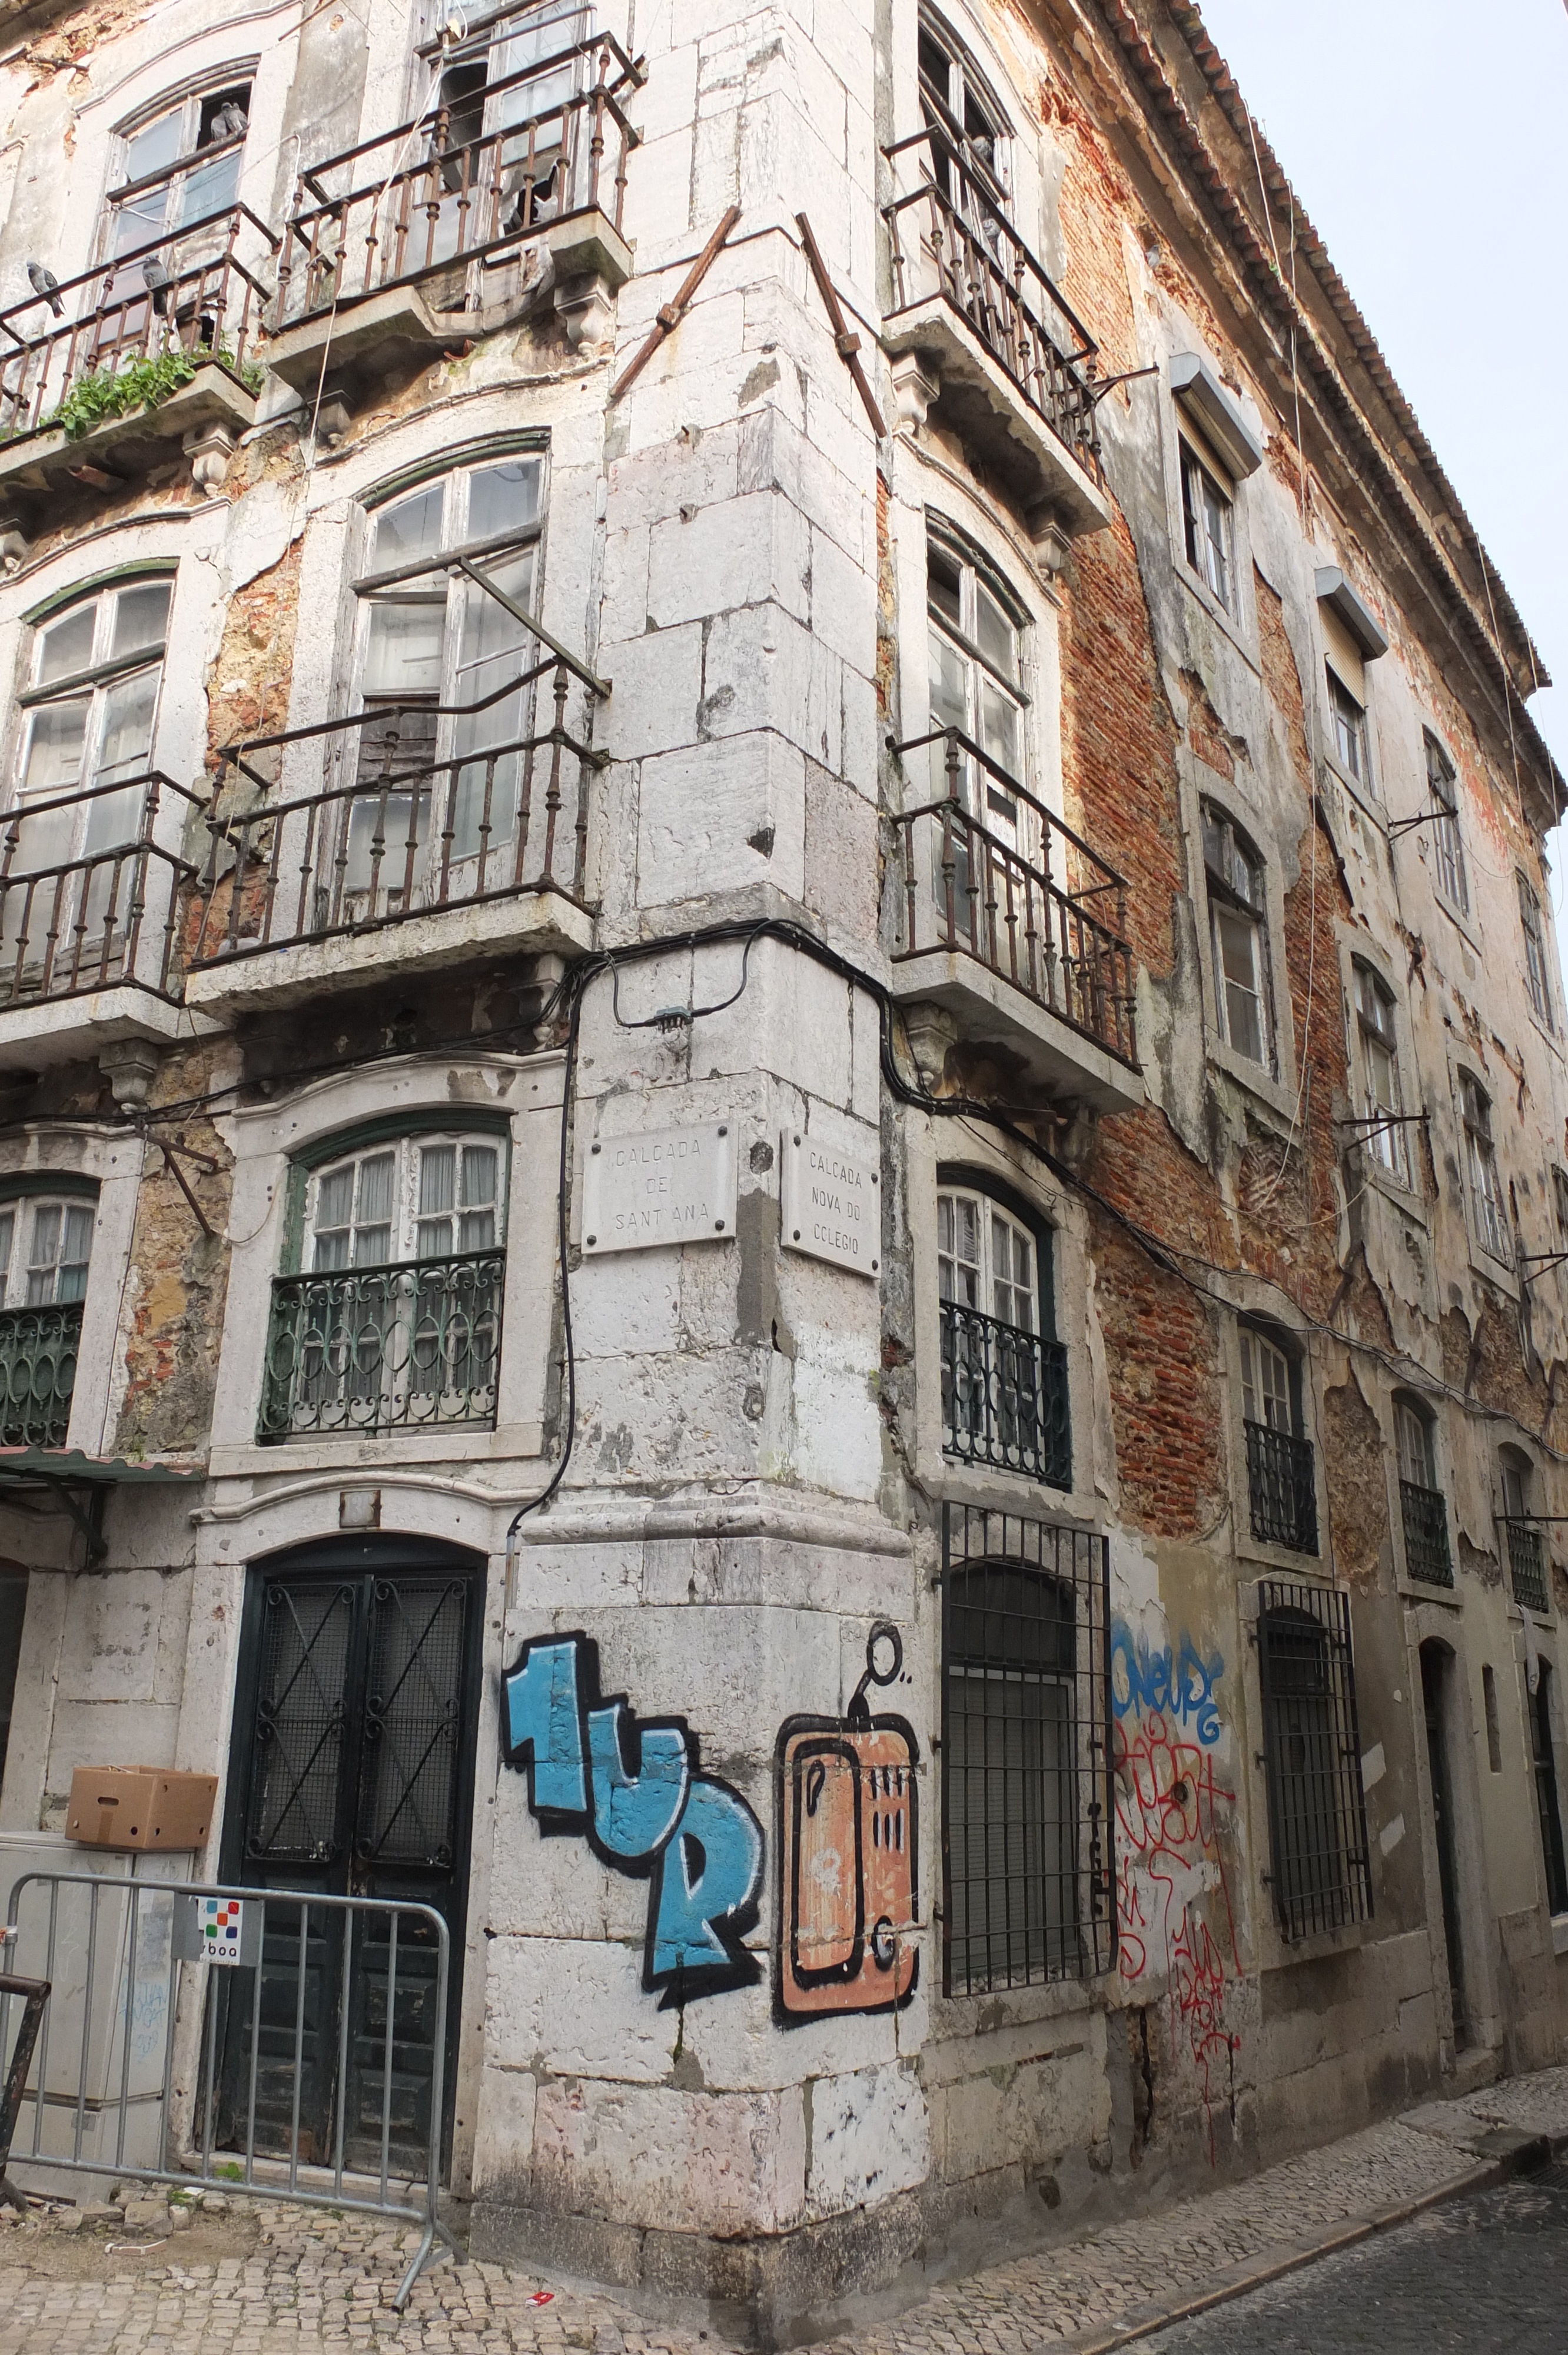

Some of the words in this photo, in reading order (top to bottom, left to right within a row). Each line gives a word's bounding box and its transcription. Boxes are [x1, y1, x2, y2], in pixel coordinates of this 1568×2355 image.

[646, 1177, 667, 1194] DE
[812, 1186, 841, 1214] NOVA
[847, 1202, 861, 1221] DO
